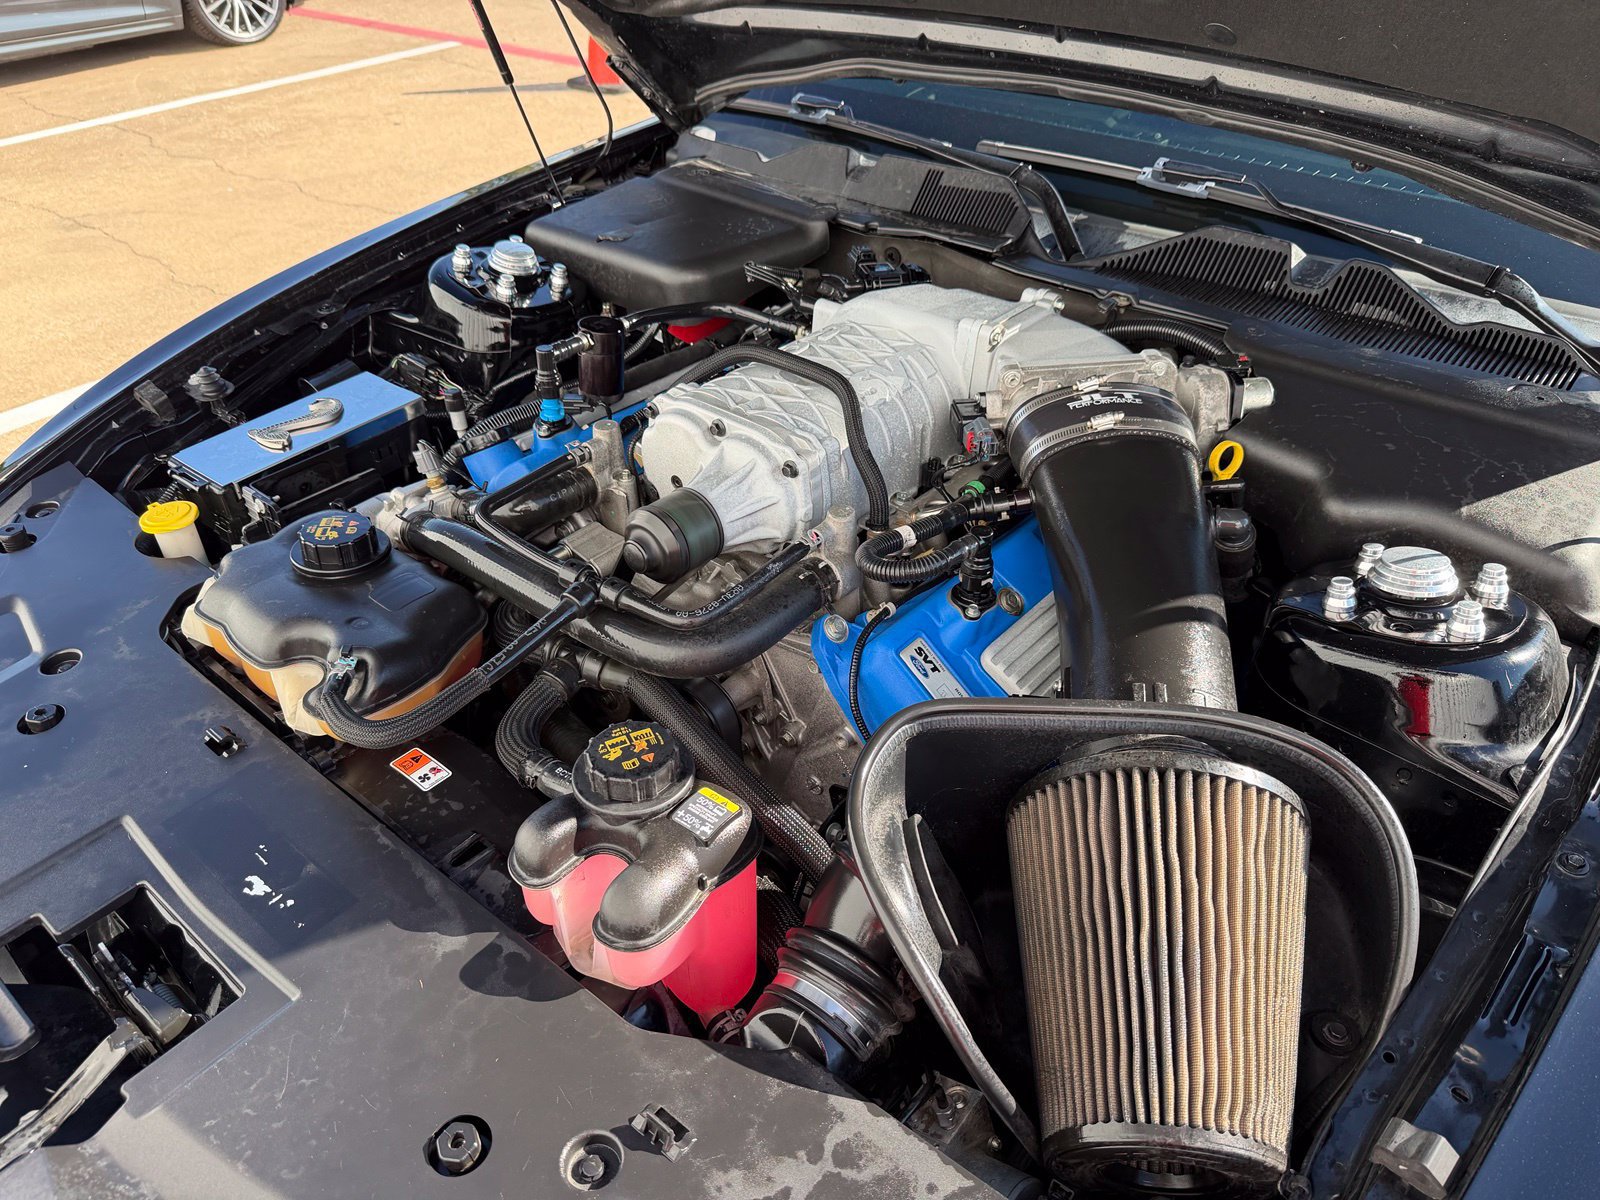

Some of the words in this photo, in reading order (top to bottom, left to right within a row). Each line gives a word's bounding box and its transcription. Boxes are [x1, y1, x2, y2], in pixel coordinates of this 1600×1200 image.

[1068, 397, 1143, 410] PERFORMANCE
[914, 646, 941, 673] SVT
[696, 796, 716, 810] 50%
